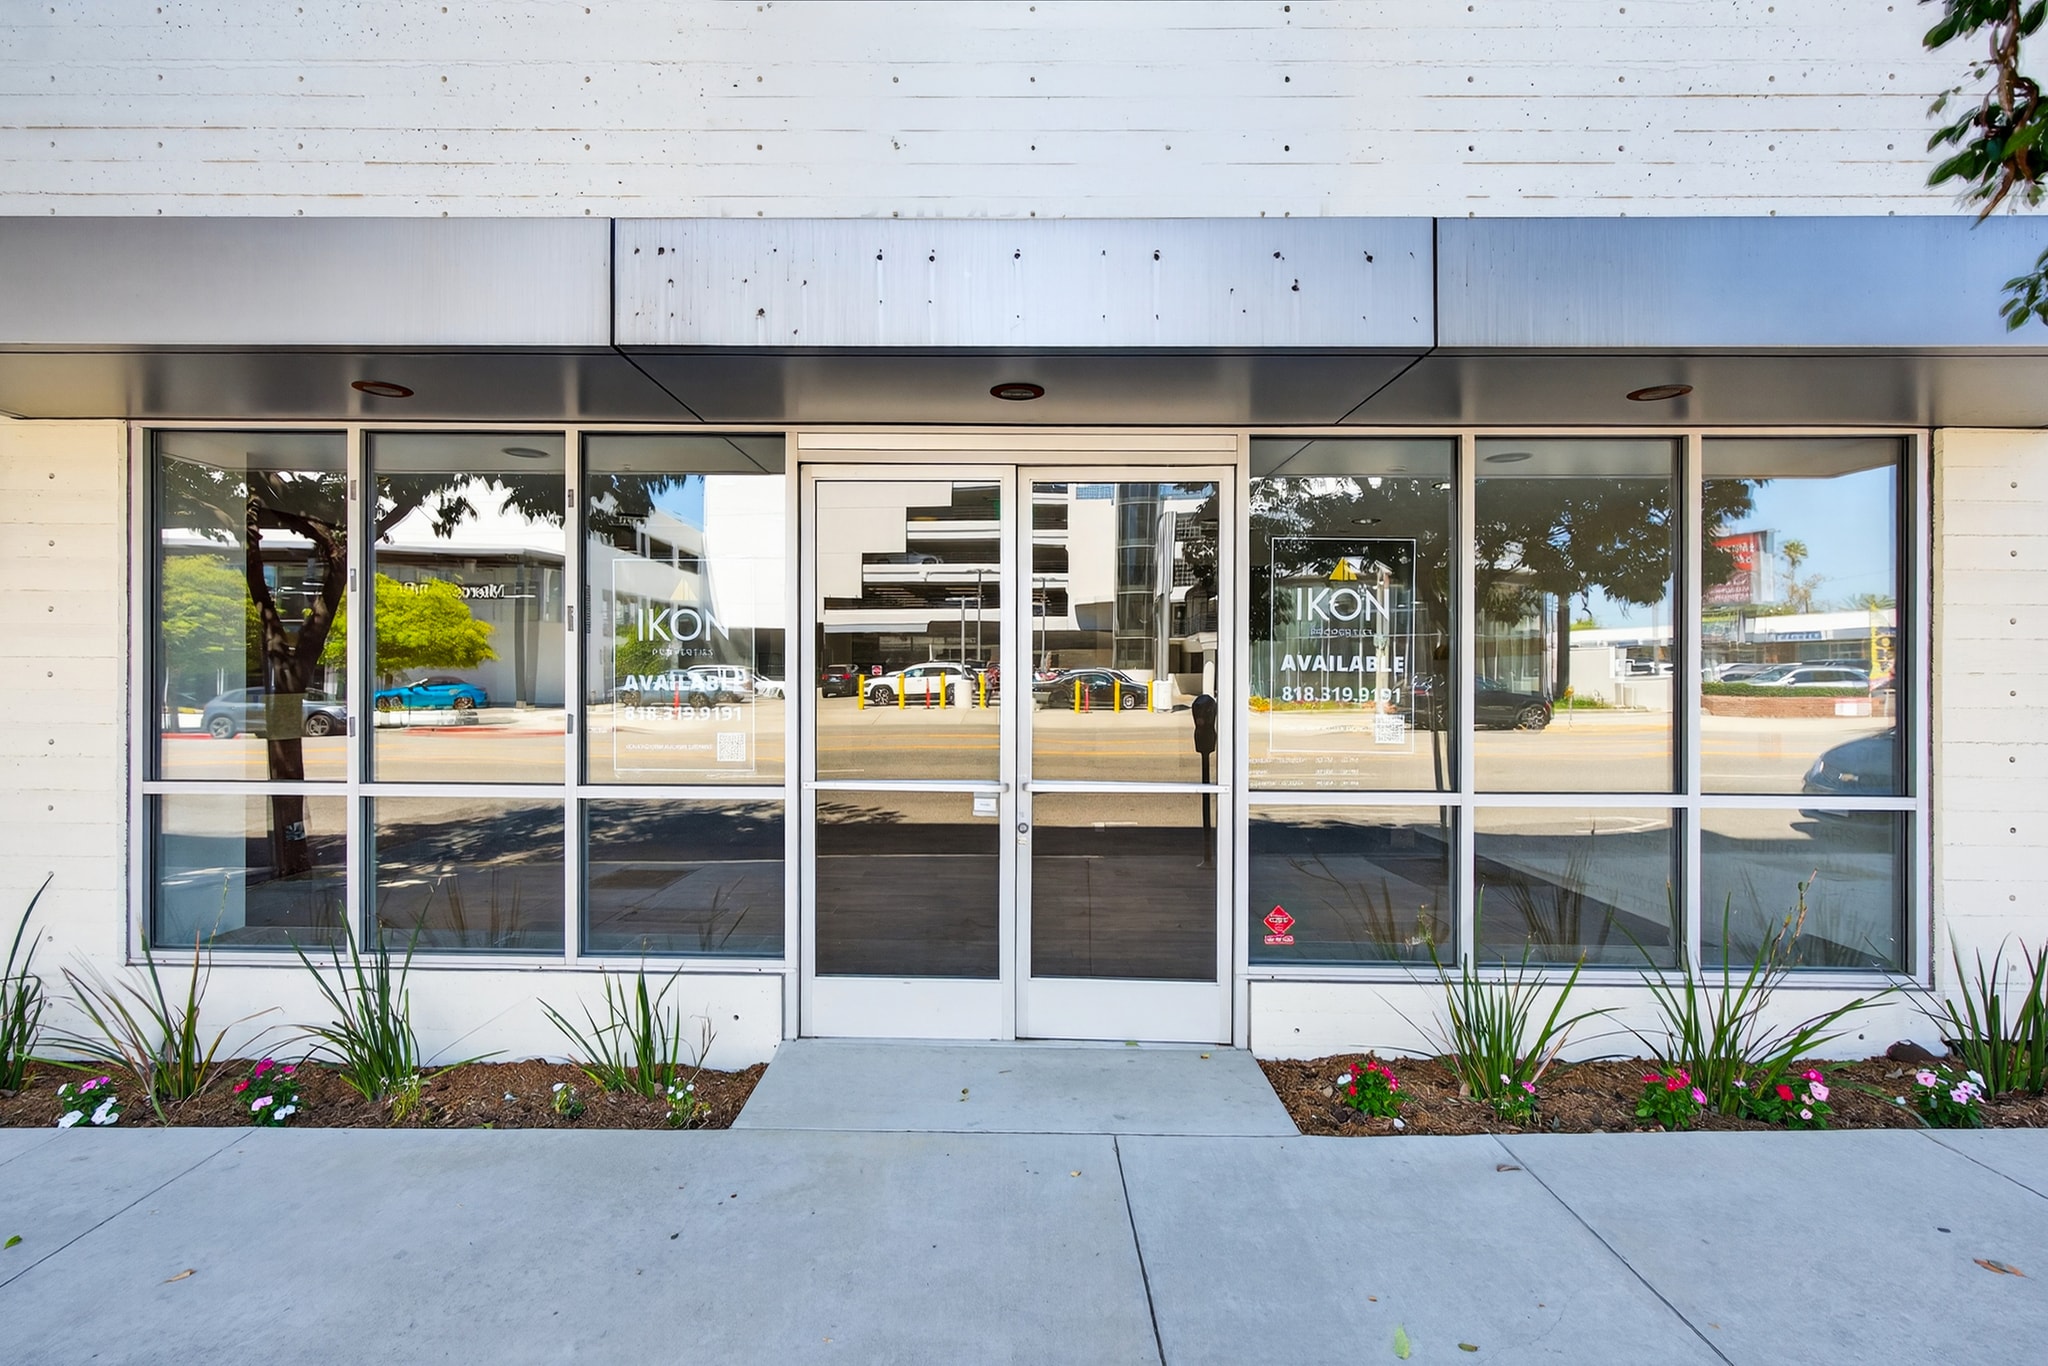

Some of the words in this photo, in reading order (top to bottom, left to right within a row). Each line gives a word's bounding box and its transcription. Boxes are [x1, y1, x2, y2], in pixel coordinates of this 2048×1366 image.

[1296, 587, 1390, 621] IKON
[638, 608, 730, 641] IKON
[1280, 654, 1404, 673] AVAILABLE
